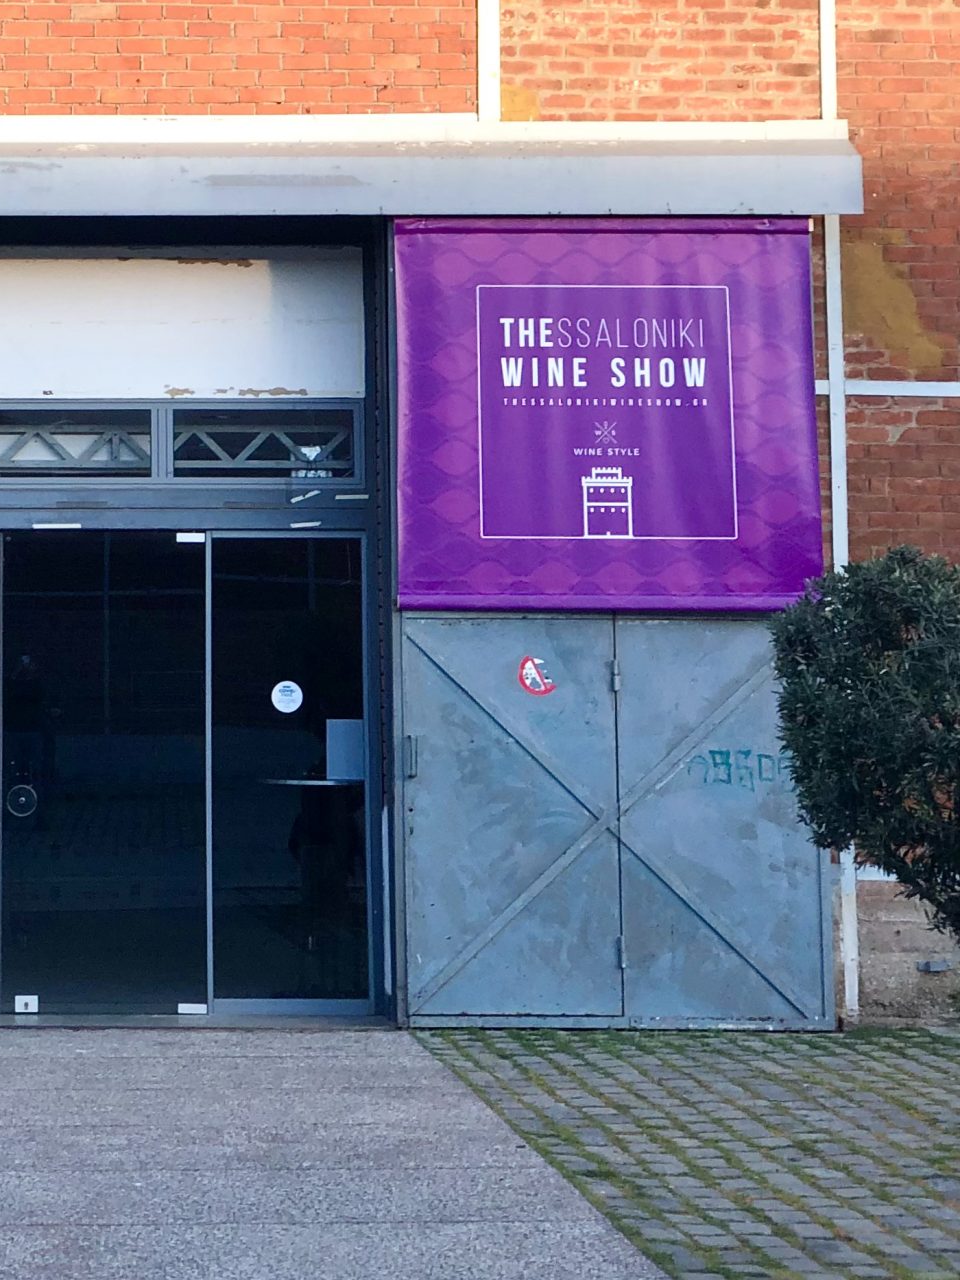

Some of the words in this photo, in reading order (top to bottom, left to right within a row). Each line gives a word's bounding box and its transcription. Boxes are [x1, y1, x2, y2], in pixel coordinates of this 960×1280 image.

[499, 317, 705, 348] THESSALONIKI
[500, 356, 588, 388] WINE
[610, 356, 706, 388] SHOW
[573, 447, 603, 456] WINE
[607, 447, 640, 456] STYLE
